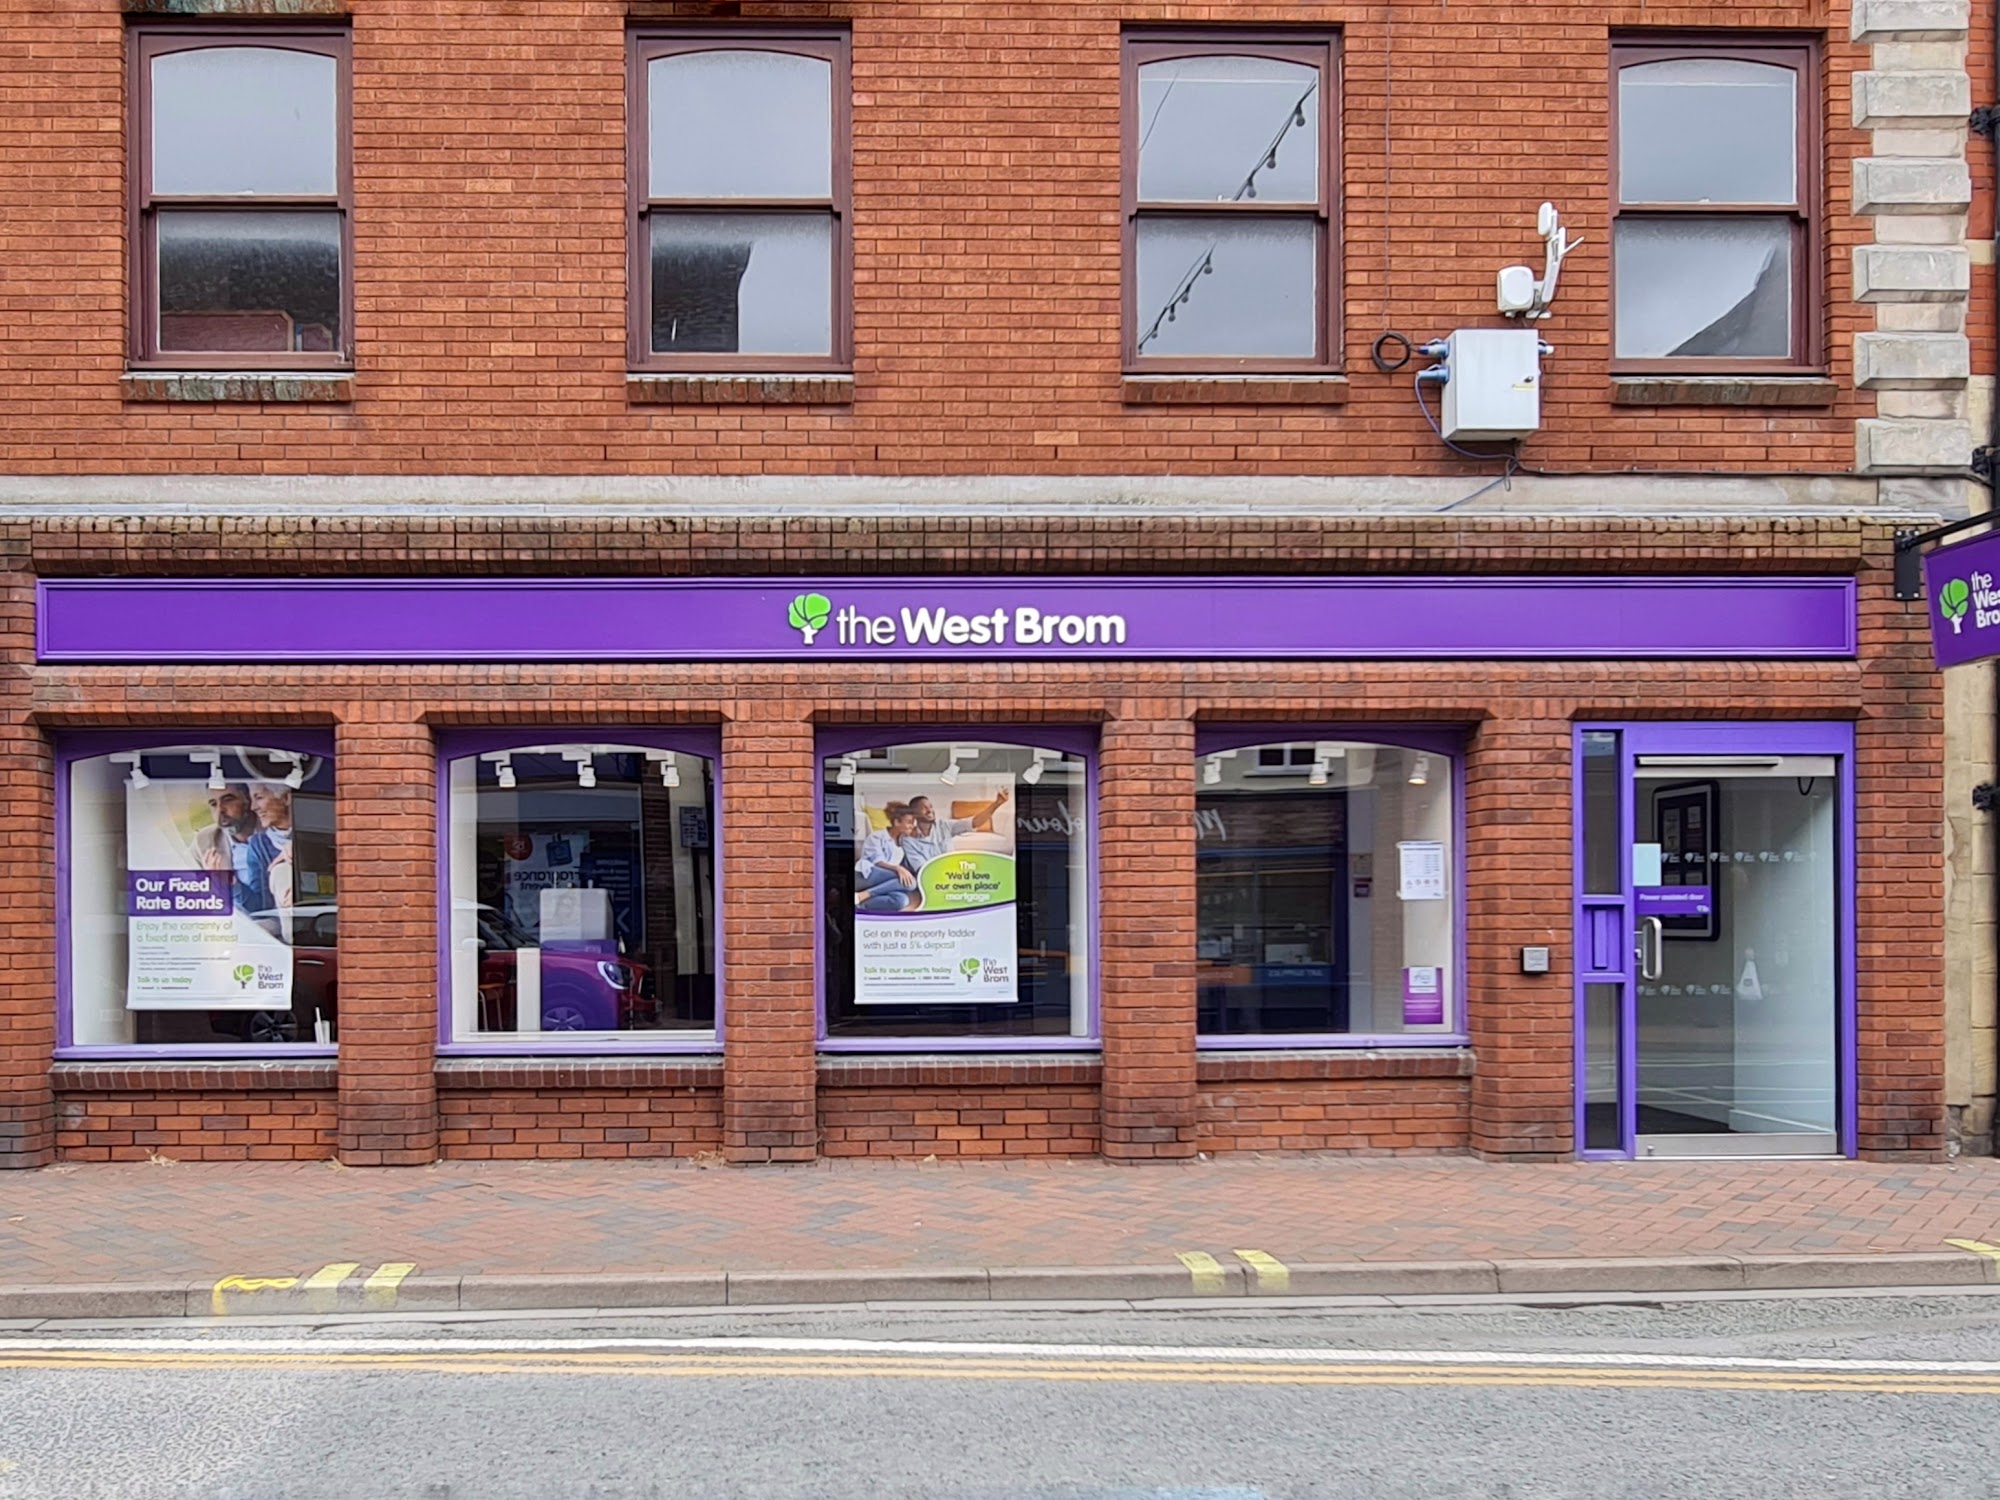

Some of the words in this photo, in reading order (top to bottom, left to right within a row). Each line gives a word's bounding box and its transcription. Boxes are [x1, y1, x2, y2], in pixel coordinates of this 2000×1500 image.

[1971, 571, 1992, 591] the
[1973, 589, 2000, 609] Wes
[1975, 609, 2000, 628] Bro
[836, 605, 896, 645] the
[900, 607, 1009, 645] West
[1014, 607, 1126, 645] Brom
[959, 861, 976, 870] The
[972, 872, 990, 880] love
[135, 878, 165, 892] Our
[169, 877, 209, 892] Fixed
[136, 896, 171, 910] Rate
[175, 895, 223, 909] Bonds
[945, 894, 990, 902] mortgage
[137, 922, 159, 931] Enjoy
[163, 921, 177, 929] the
[180, 922, 220, 931] certainty
[223, 921, 233, 929] of
[146, 933, 167, 942] fixed
[171, 934, 189, 942] rate
[192, 933, 201, 942] of
[204, 934, 238, 942] interest
[863, 930, 877, 938] Get
[894, 930, 907, 938] the
[910, 930, 946, 939] property
[863, 941, 881, 949] with
[883, 942, 898, 951] just
[924, 941, 955, 950] deposit
[903, 967, 930, 975] experts
[932, 967, 952, 975] today
[983, 966, 1008, 974] West
[258, 973, 283, 981] West
[258, 981, 284, 989] Brom
